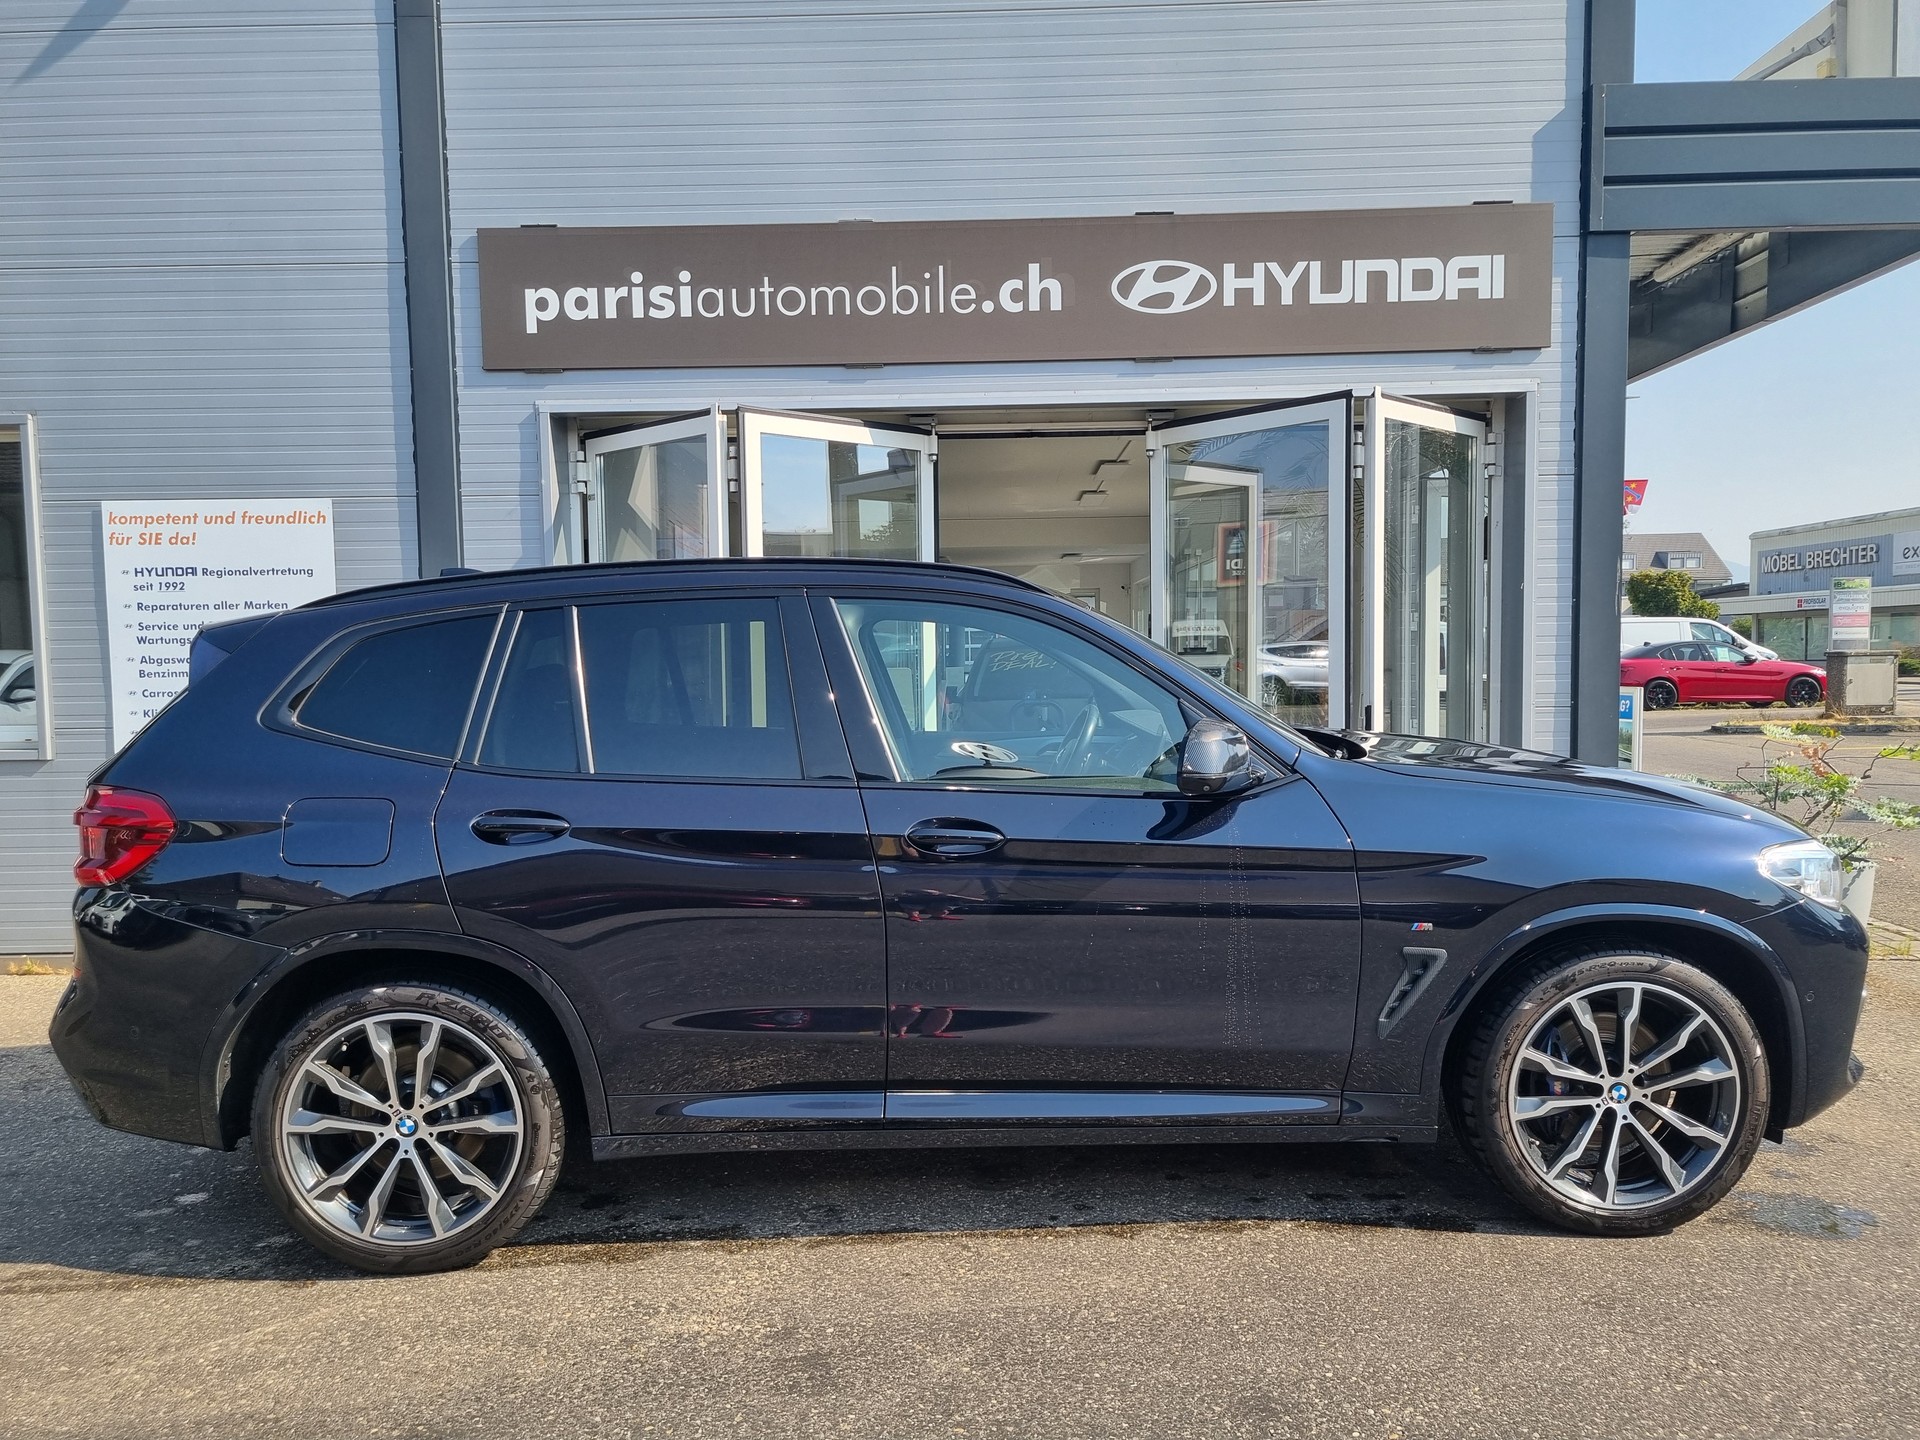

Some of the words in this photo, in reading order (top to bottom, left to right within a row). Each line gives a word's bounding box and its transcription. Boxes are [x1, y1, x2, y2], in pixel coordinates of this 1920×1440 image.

[1223, 254, 1505, 306] HYUNDAI
[525, 263, 1062, 334] parisiautomobile.ch
[108, 511, 198, 528] kompetent
[203, 511, 236, 525] und
[241, 510, 327, 525] freundlich
[108, 532, 133, 545] für
[137, 532, 163, 546] SIE
[168, 532, 197, 545] da!
[1761, 552, 1802, 573] MÖBEL
[1805, 543, 1878, 569] BRECHTER
[134, 566, 198, 578] HYUNDAI
[201, 566, 314, 579] Regionalvertretung
[133, 582, 153, 592] seit
[157, 581, 186, 592] 1992
[136, 602, 210, 613] Reparaturen
[213, 601, 240, 610] aller
[243, 600, 289, 610] Marken
[138, 621, 179, 631] Service
[136, 636, 193, 646] Wartungs
